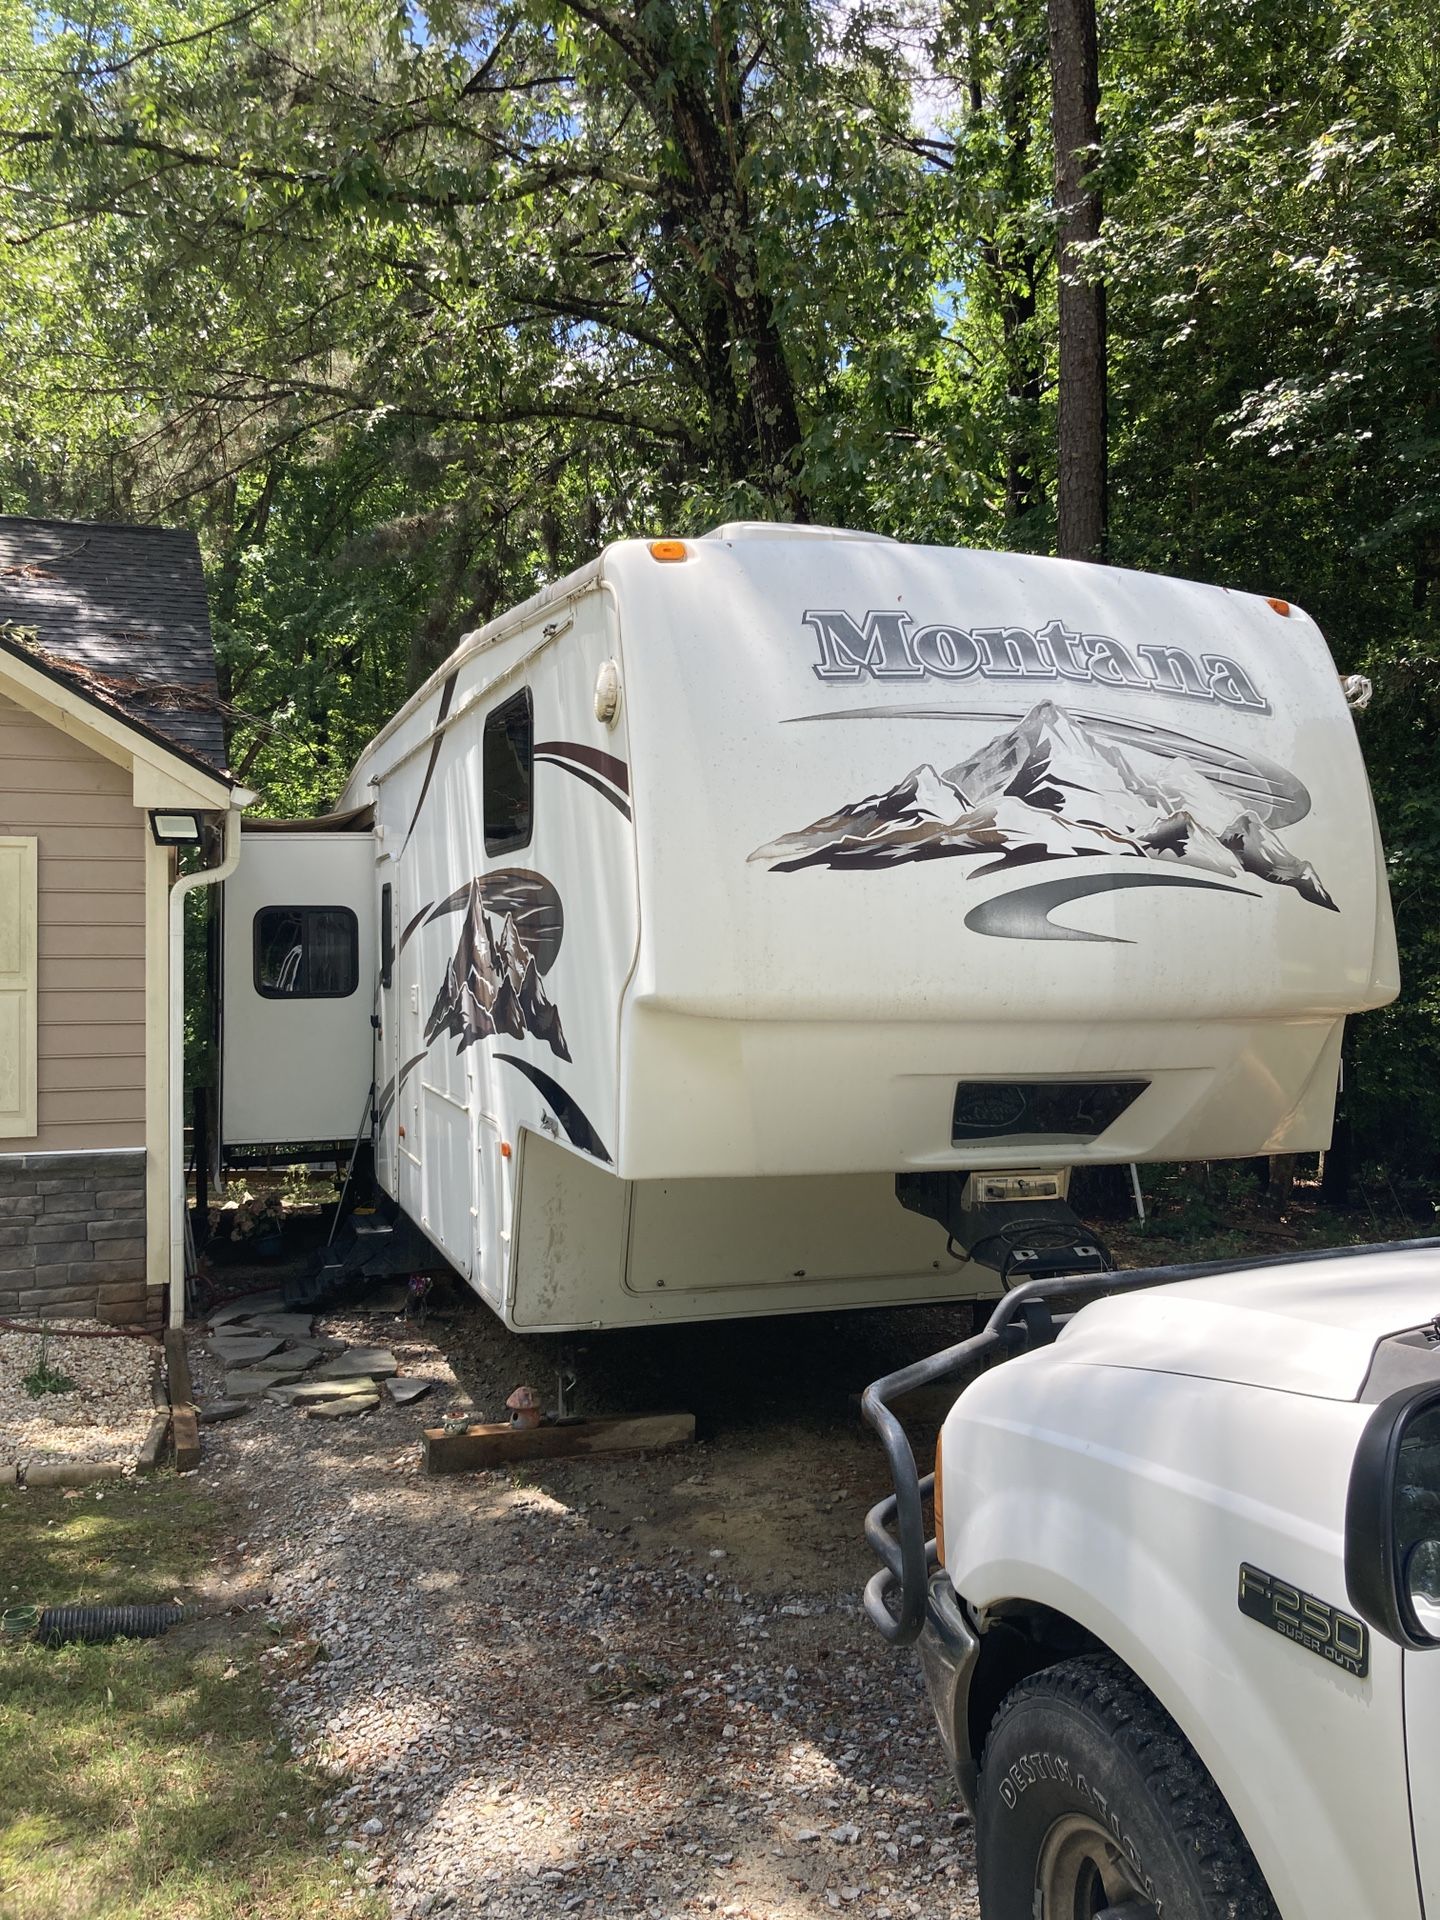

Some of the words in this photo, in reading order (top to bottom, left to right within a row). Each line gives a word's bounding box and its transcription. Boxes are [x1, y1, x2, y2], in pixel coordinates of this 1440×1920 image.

[802, 609, 1272, 715] Montana
[1277, 1620, 1321, 1652] SUPER
[1324, 1646, 1363, 1674] DUTY
